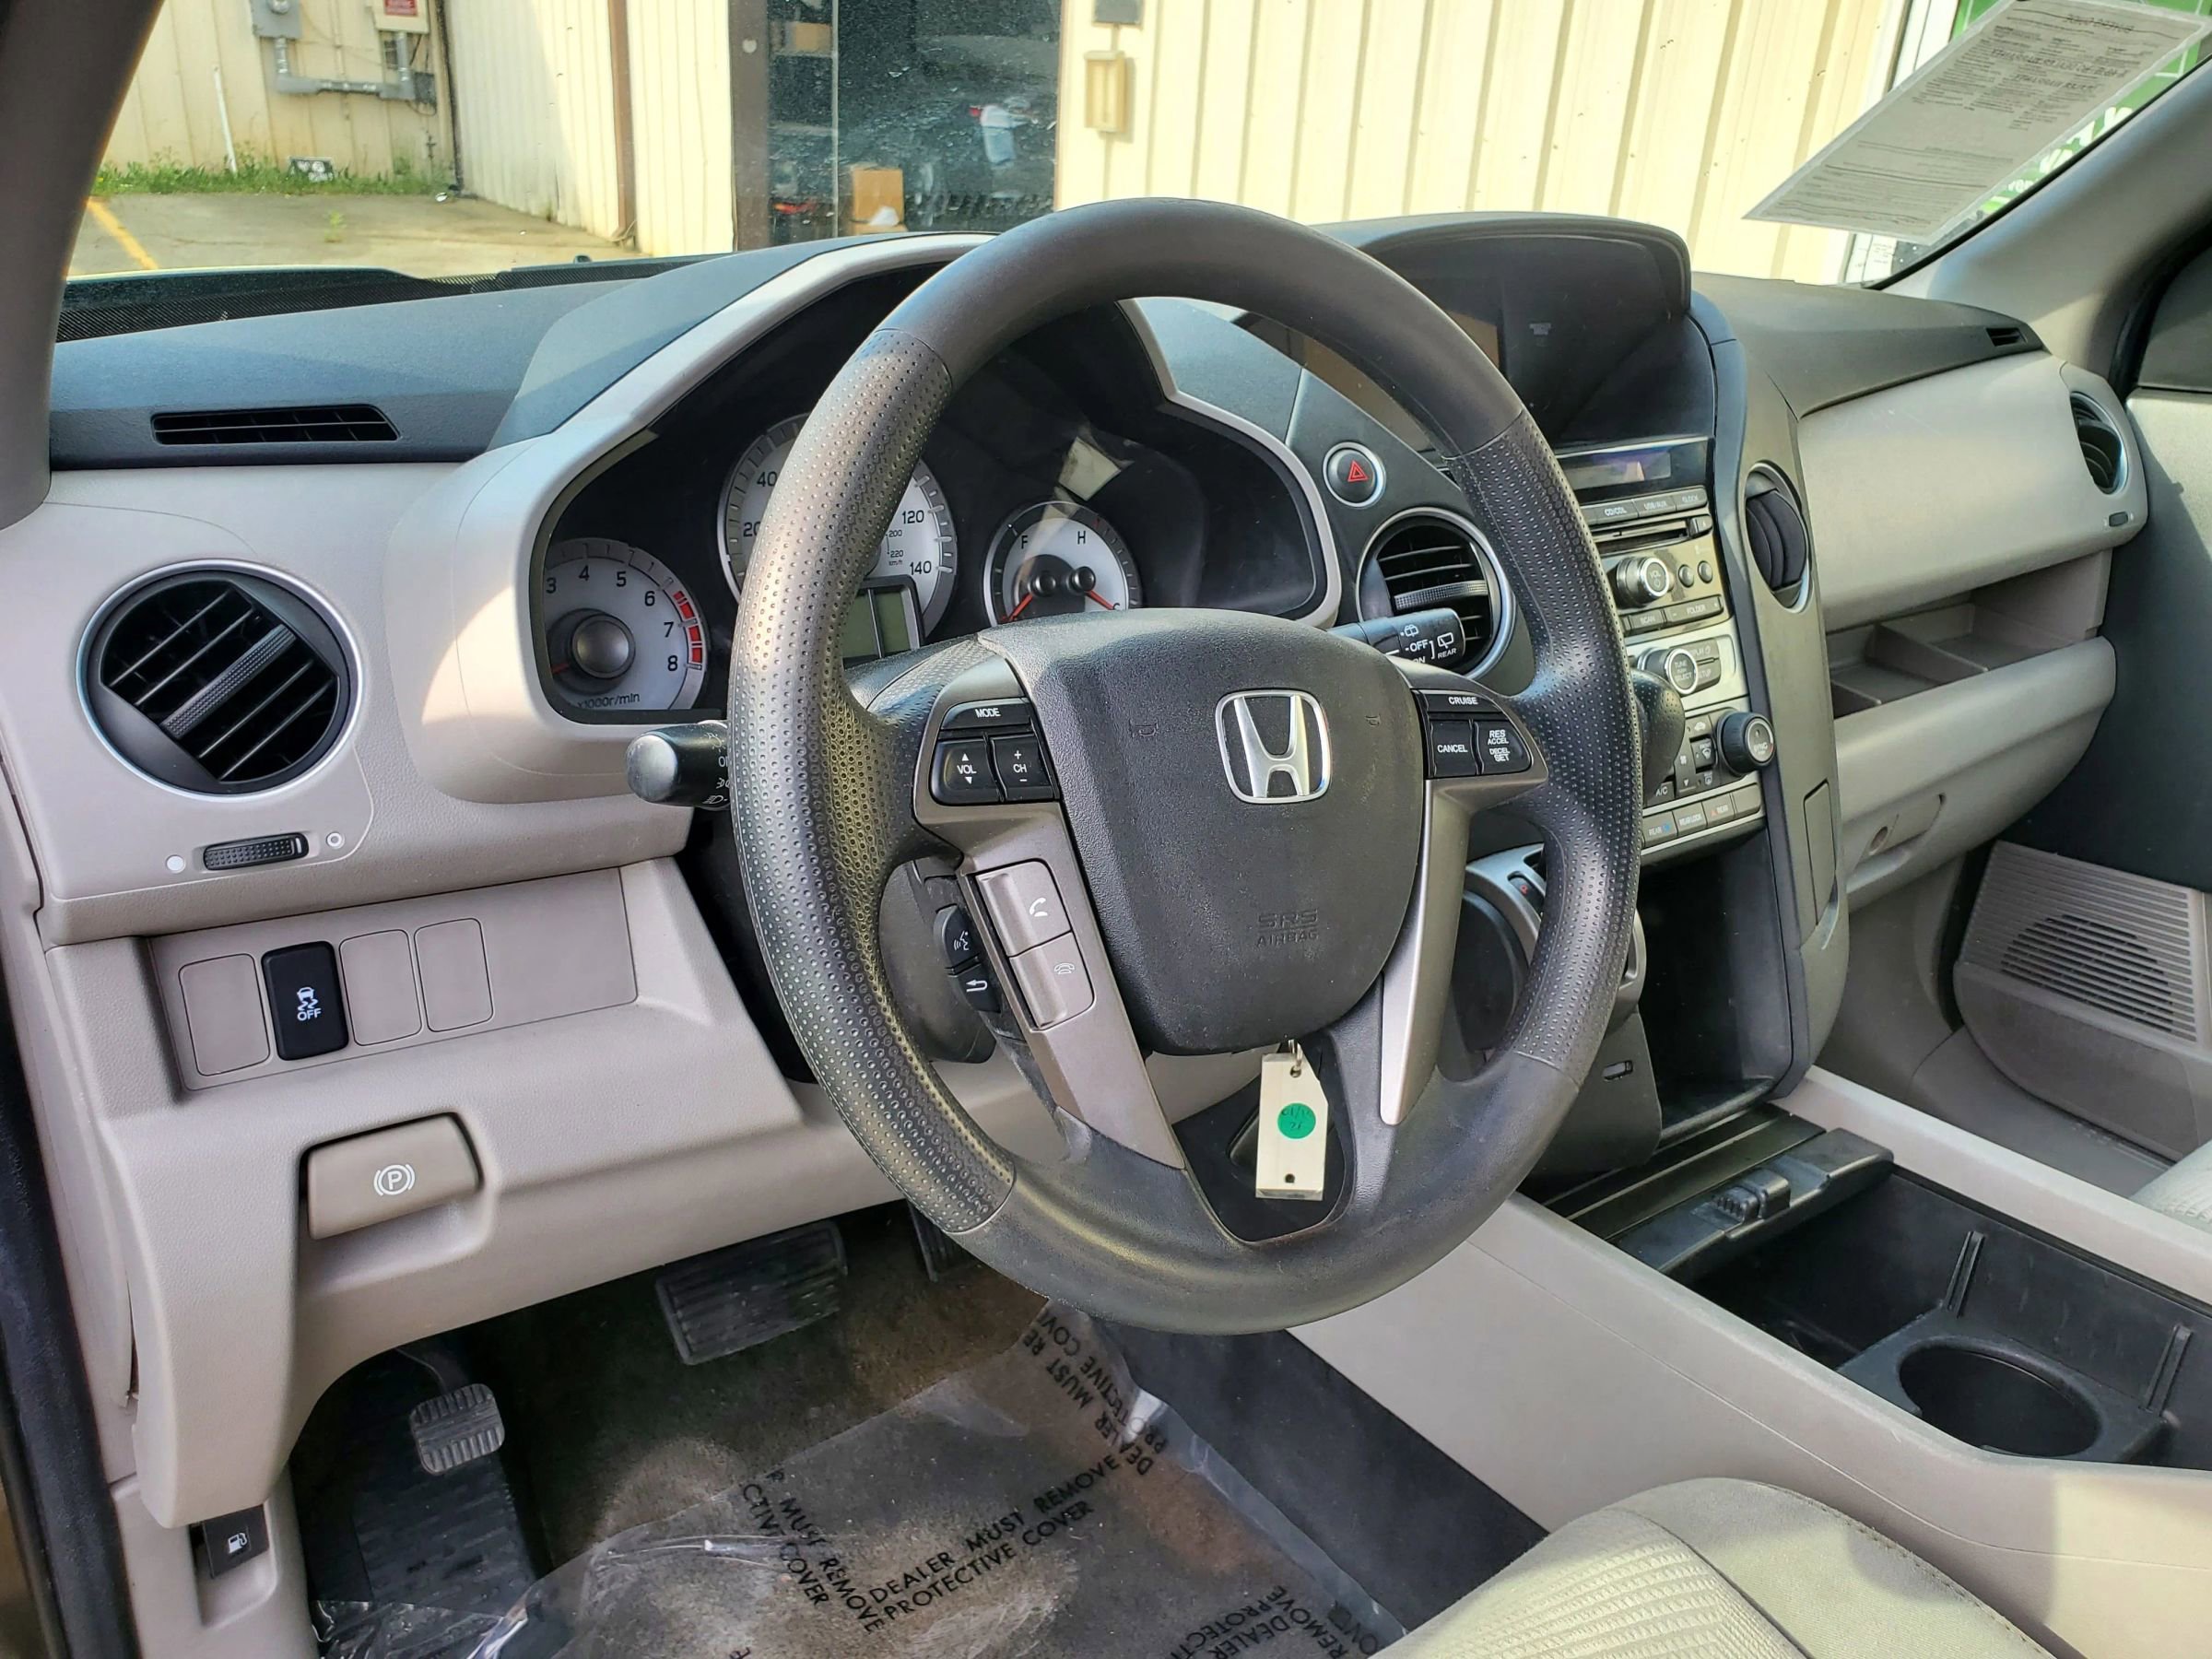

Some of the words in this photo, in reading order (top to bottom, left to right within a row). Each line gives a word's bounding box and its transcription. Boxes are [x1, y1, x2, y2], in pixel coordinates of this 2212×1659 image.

[901, 510, 925, 524] 120
[1020, 535, 1029, 549] F
[1077, 530, 1087, 545] H
[578, 565, 590, 582] 4
[910, 560, 933, 576] 140
[546, 577, 558, 594] 3
[616, 571, 627, 588] 5
[644, 590, 656, 607] 6
[664, 621, 675, 638] 7
[1409, 639, 1429, 653] OFF
[1437, 648, 1457, 659] REAR
[666, 654, 679, 672] 8
[1448, 696, 1478, 705] CRUISE
[975, 708, 1002, 718] MODE
[1489, 729, 1506, 738] RES
[1437, 744, 1468, 753] CANCEL
[1488, 737, 1510, 746] ACCEL
[1489, 747, 1511, 756] DECEL
[1494, 753, 1510, 762] SET
[957, 764, 977, 774] VOL
[1013, 763, 1028, 773] CH
[1655, 786, 1668, 797] A/C
[297, 1007, 322, 1021] OFF
[1045, 1358, 1095, 1411] MUST
[869, 1550, 956, 1606] DEALER
[965, 1510, 1025, 1555] MUST
[1033, 1454, 1121, 1514] REMOVE
[883, 1542, 1018, 1621] PROTECTIVE
[1021, 1500, 1095, 1547] COVER
[818, 1556, 885, 1635] REMOVE
